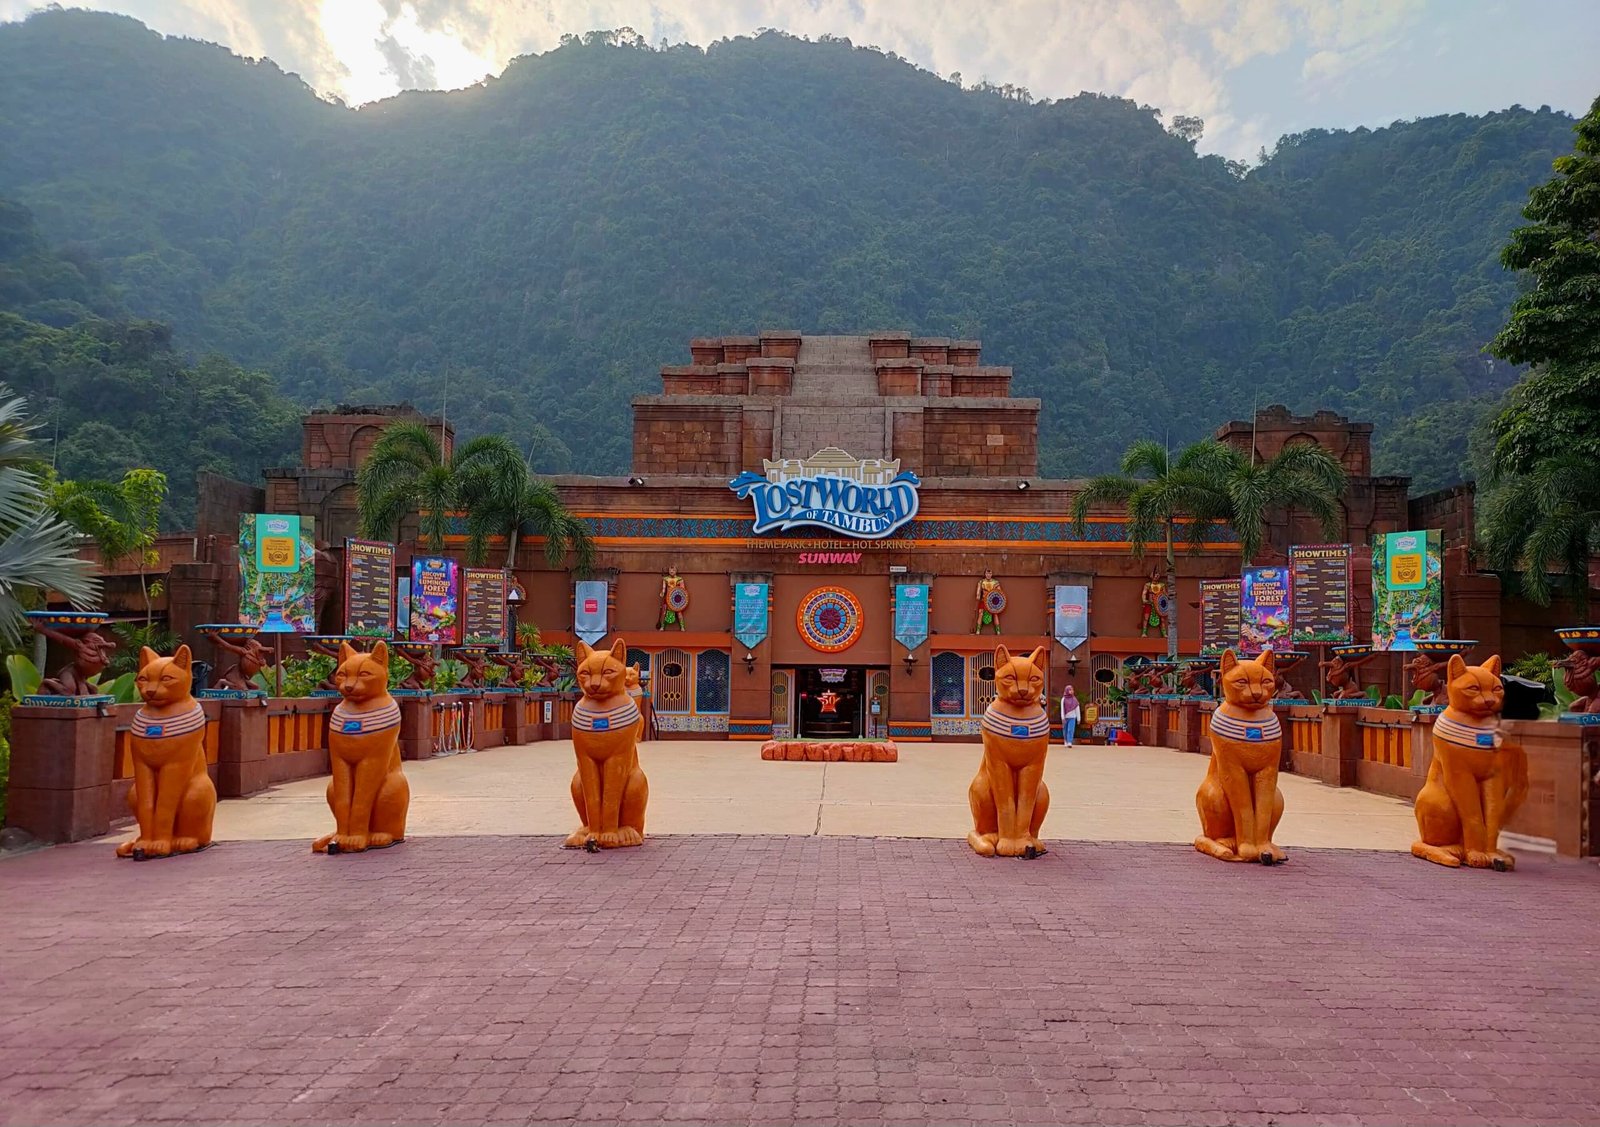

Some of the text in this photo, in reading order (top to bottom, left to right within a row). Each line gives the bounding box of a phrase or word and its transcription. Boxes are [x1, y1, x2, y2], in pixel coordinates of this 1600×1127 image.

[752, 477, 913, 528] LOST WORLD
[806, 511, 890, 532] OF TAMBUN
[351, 543, 391, 555] SHOWTIMES
[746, 540, 915, 549] THEME PARK HOTEL HOT SPRINGS
[798, 553, 862, 564] SUNWAY
[1294, 550, 1347, 558] SHOWTIMES
